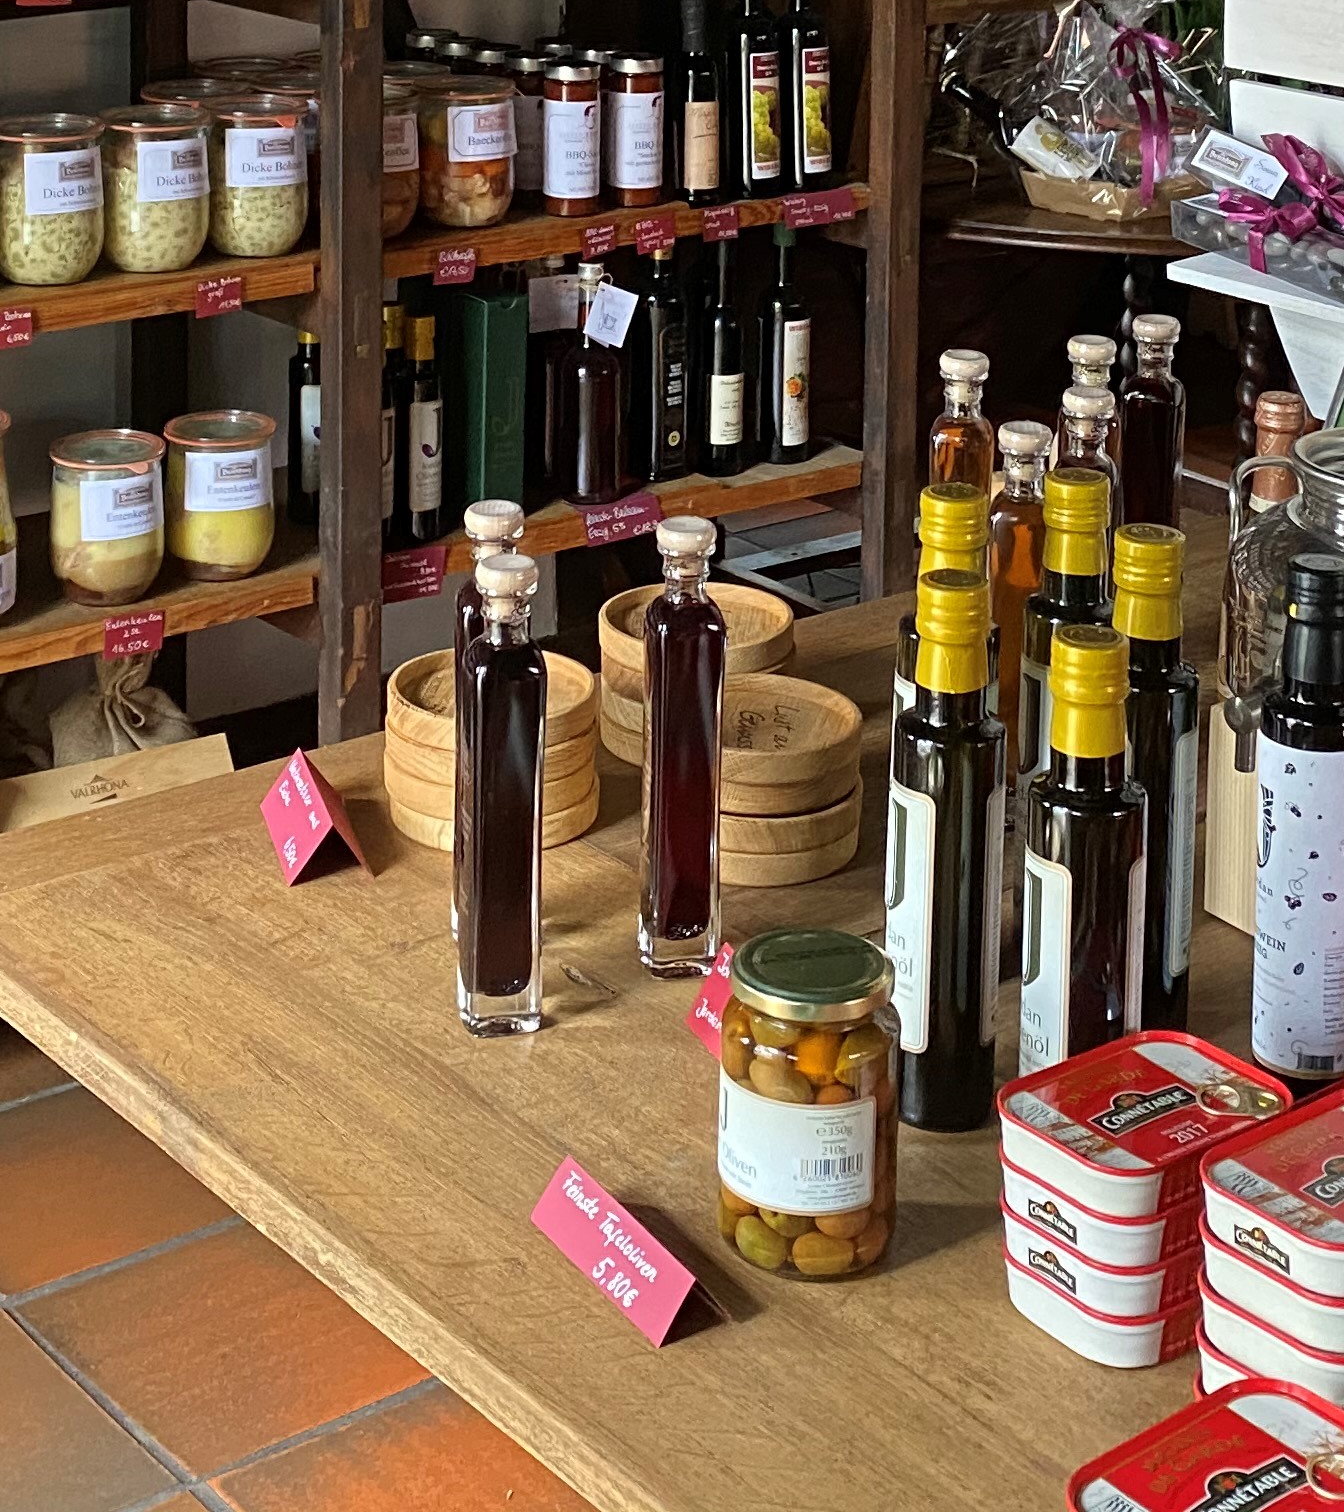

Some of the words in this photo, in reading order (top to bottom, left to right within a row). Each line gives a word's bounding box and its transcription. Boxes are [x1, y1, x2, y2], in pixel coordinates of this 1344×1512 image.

[241, 161, 273, 174] Dicke
[156, 174, 187, 187] Dicke
[42, 187, 75, 200] Dicke
[70, 778, 130, 800] VALRHONA
[1168, 1123, 1209, 1144] 2017
[560, 1168, 602, 1222] Feinste
[595, 1209, 659, 1285] Tafeloliven
[589, 1257, 639, 1309] 5,80€
